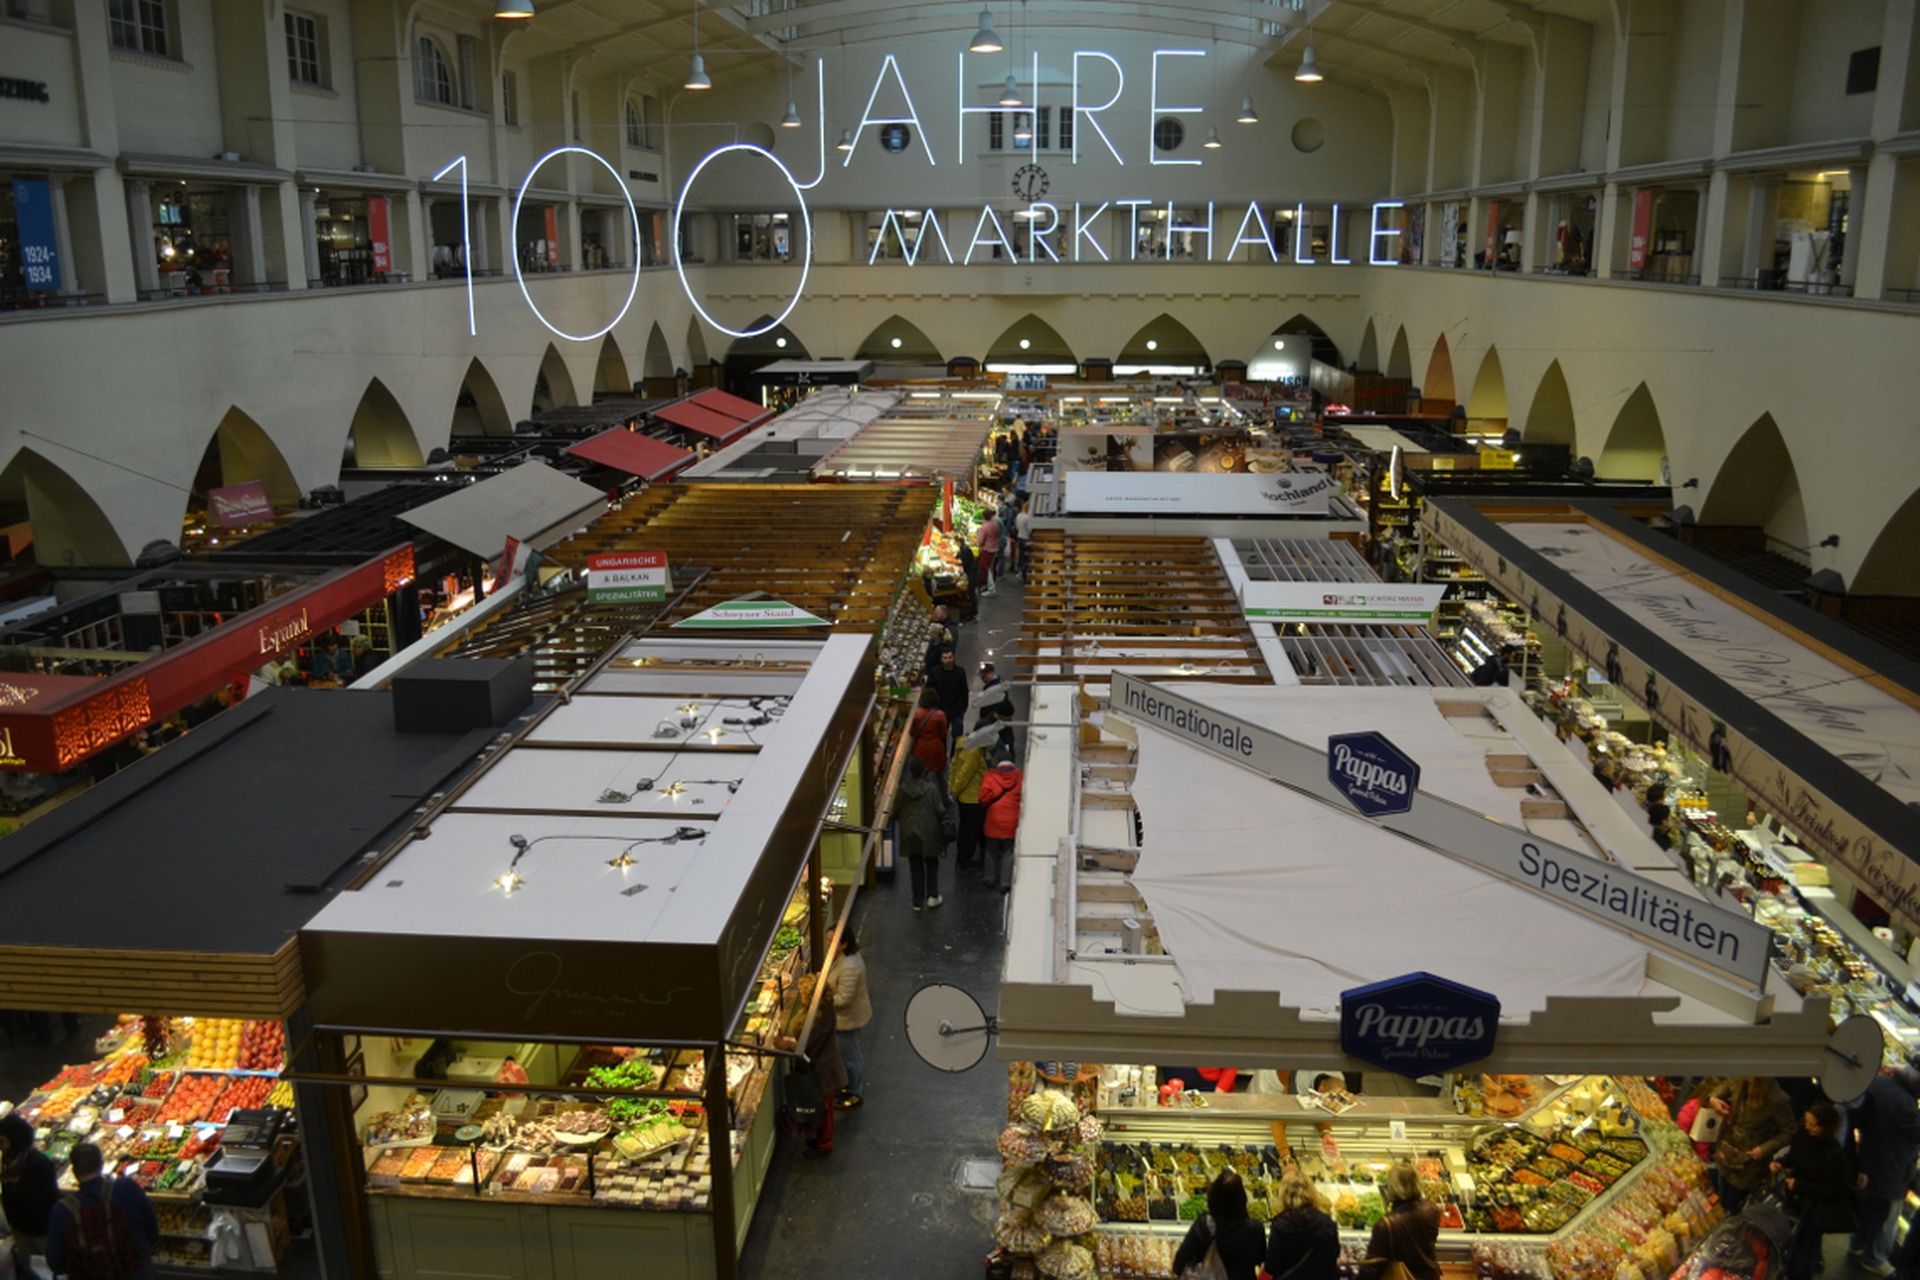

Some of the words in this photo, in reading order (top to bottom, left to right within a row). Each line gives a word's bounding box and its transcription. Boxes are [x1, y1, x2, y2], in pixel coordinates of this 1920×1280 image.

[787, 49, 1207, 190] JAHRE
[25, 246, 55, 264] 1924-
[432, 144, 812, 341] 100
[868, 199, 1405, 267] MARKTHALLE
[28, 266, 53, 284] 1934
[596, 556, 657, 567] UNGARISCHE
[613, 573, 650, 582] BALKAN
[596, 590, 658, 601] SPEZIALITÄTEN
[763, 609, 796, 618] Stand
[1123, 681, 1255, 757] Internationale
[1333, 743, 1408, 796] Pappas
[1519, 841, 1741, 962] Spezialitäten
[1353, 1002, 1486, 1049] Pappas
